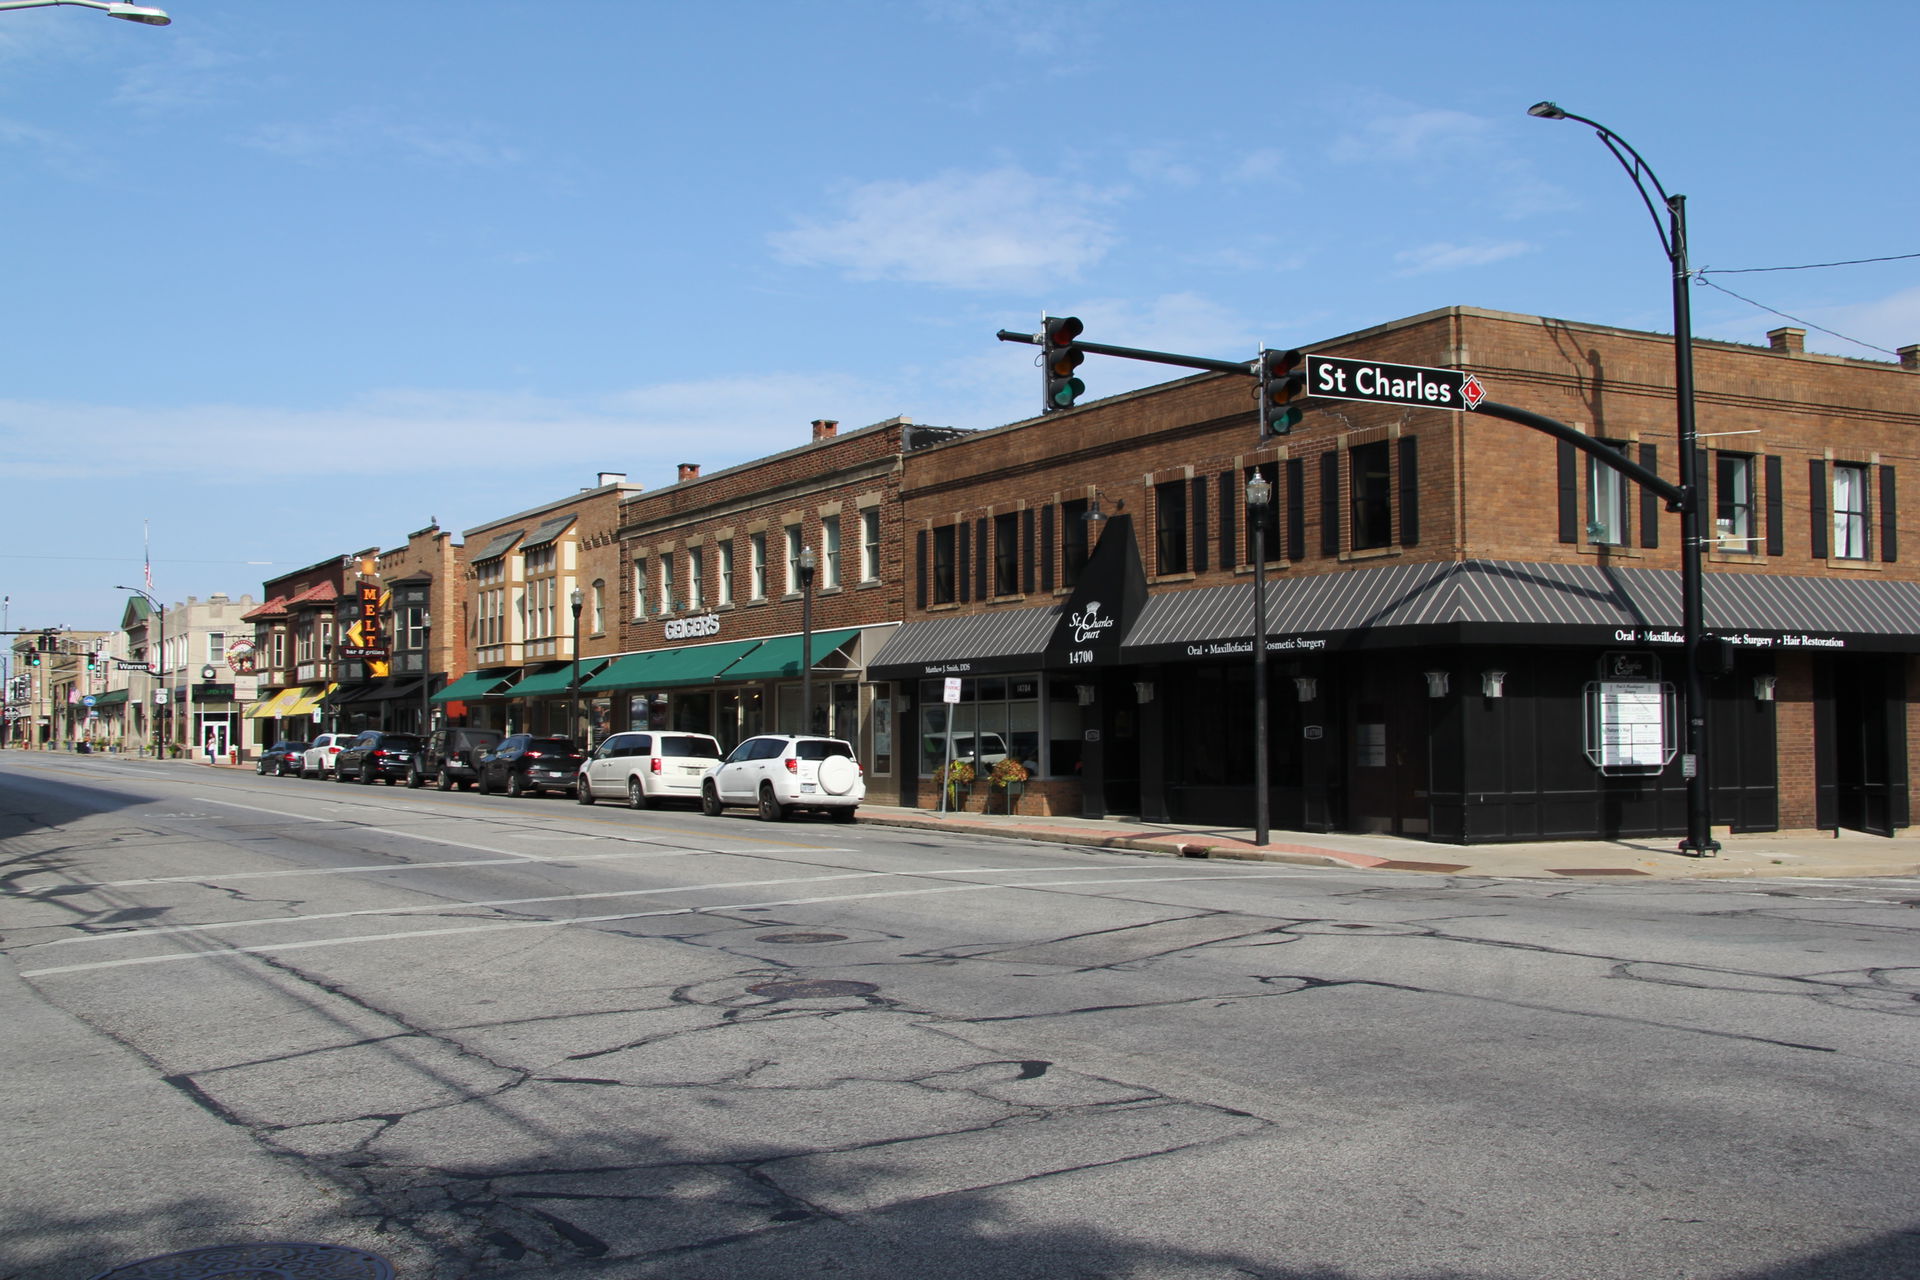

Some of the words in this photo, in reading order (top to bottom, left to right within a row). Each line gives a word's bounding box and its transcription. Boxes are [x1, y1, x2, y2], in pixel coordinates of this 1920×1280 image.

[1318, 363, 1347, 392] St
[1355, 367, 1451, 403] Charles
[1468, 386, 1477, 398] L
[363, 588, 377, 647] MELT
[664, 613, 720, 640] GEIGER'S
[1082, 611, 1114, 630] Charles
[1075, 624, 1100, 643] Court
[1615, 629, 1634, 641] Oral
[1643, 630, 1685, 643] Maxillofac
[1743, 633, 1773, 647] Surgery
[1782, 634, 1801, 646] Hair
[1801, 635, 1844, 647] Restoration
[1187, 645, 1203, 656] Oral
[1209, 641, 1253, 654] Maxillofacial
[1265, 638, 1296, 650] osmetic
[1296, 637, 1326, 650] Surgery
[1069, 650, 1093, 664] 14700
[960, 663, 971, 672] DDS
